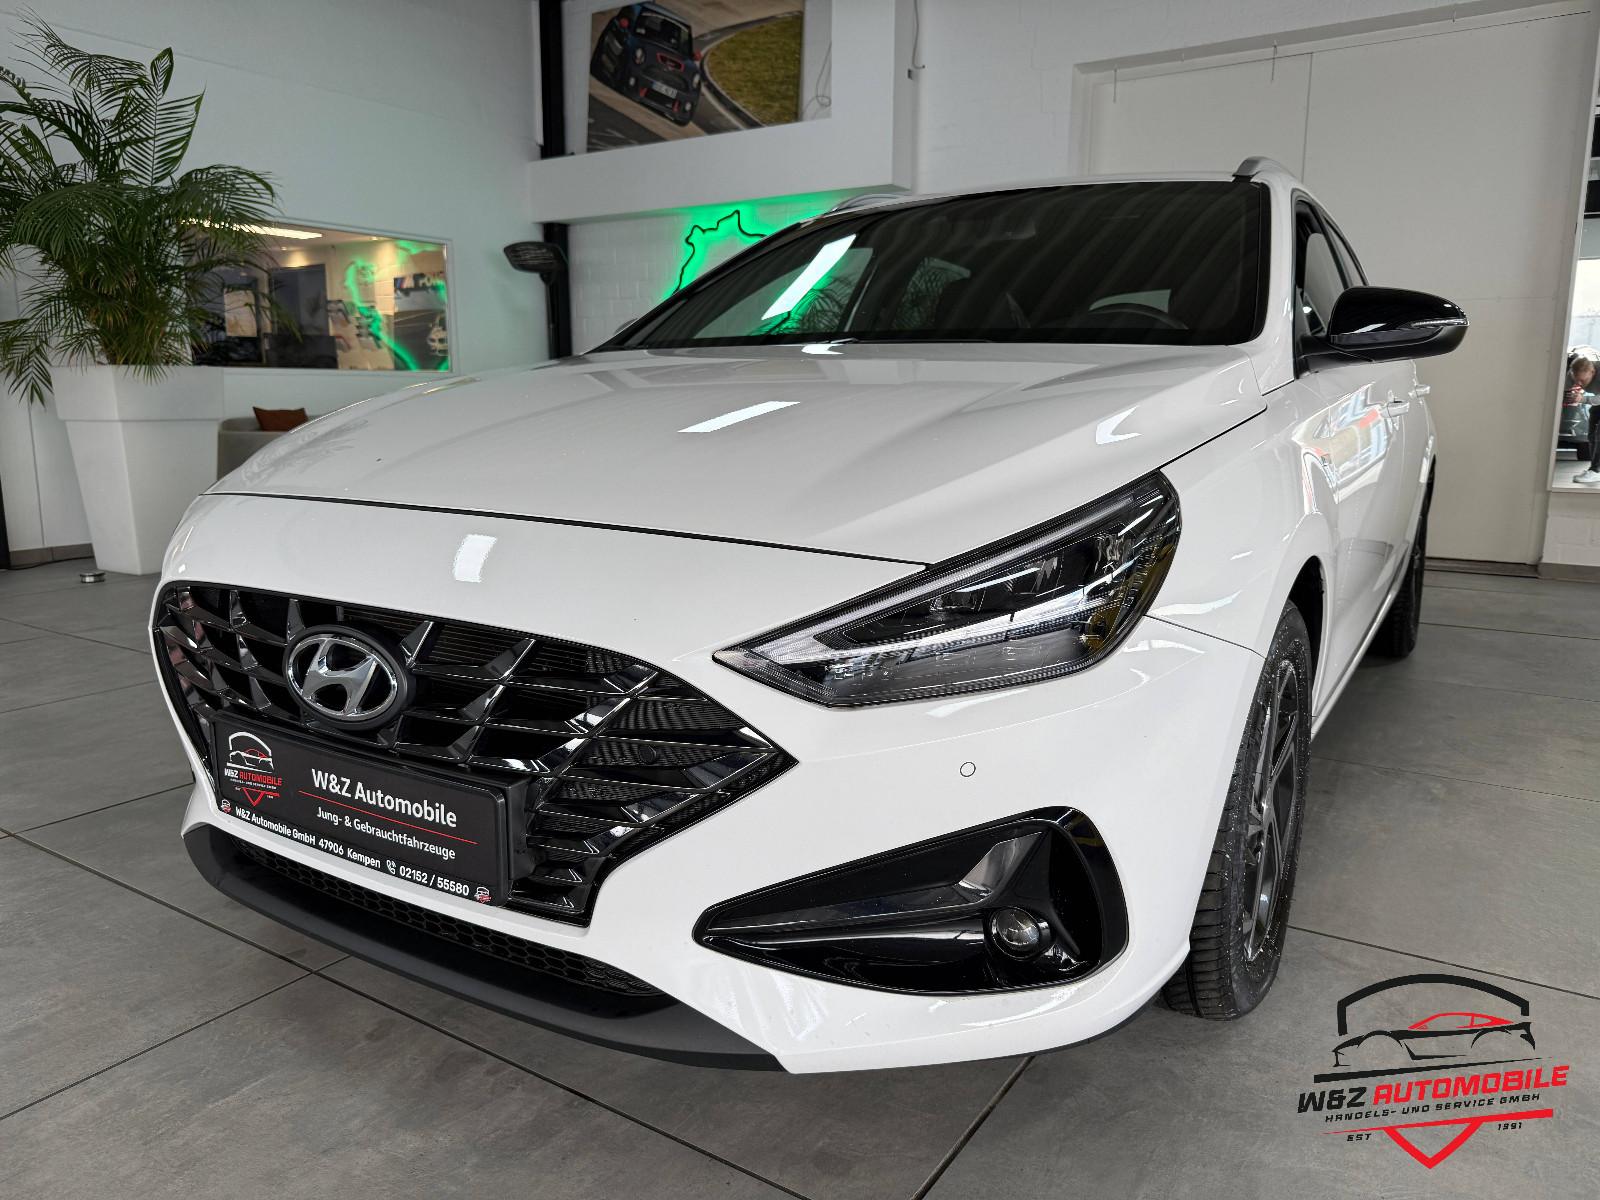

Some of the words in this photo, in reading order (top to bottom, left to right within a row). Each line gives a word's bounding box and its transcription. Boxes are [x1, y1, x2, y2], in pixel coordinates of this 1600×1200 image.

[239, 771, 283, 786] AUTOMOBILE
[311, 768, 352, 798] W&Z
[354, 781, 457, 828] Automobile
[235, 806, 251, 820] W&Z
[251, 812, 292, 837] Automobile
[292, 828, 316, 846] GmbH
[318, 838, 344, 856] 47906
[347, 847, 381, 869] Kempen
[399, 865, 428, 884] 02152
[429, 874, 436, 887] /
[437, 876, 470, 896] 55580
[316, 806, 342, 826] Jung-
[344, 815, 352, 828] &
[353, 818, 456, 860] Gebrauchtfahrzeuge
